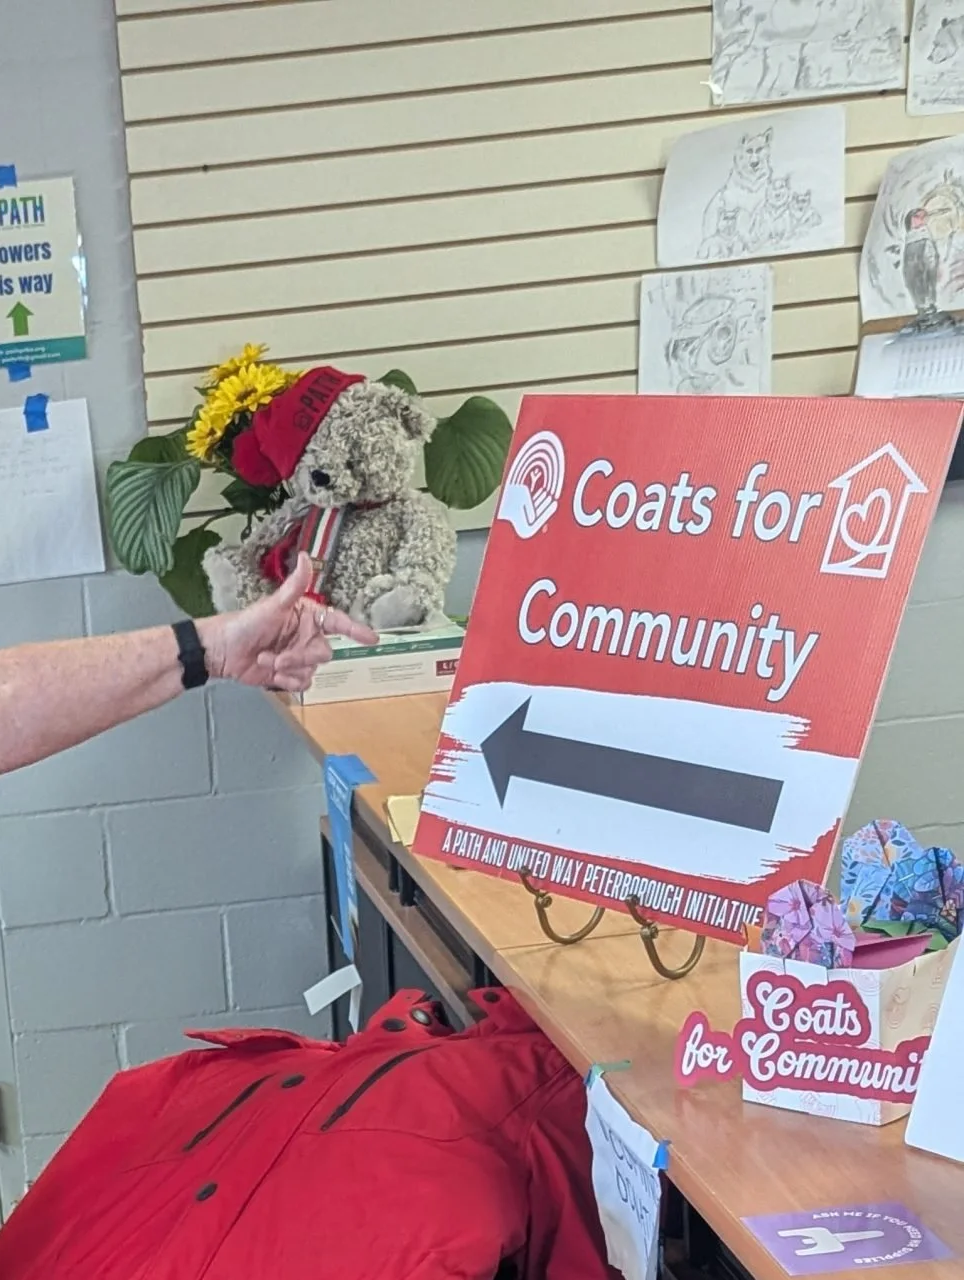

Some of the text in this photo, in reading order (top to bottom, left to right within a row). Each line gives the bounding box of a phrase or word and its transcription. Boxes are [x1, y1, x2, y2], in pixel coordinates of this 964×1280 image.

[18, 273, 53, 294] way
[572, 459, 823, 543] Coats for
[517, 578, 819, 702] Community
[442, 827, 763, 932] A PATH AND UNITED WAY PETERBOROUGH INITIATIVE
[755, 981, 862, 1036] Coats
[682, 1023, 926, 1093] for Communi
[813, 1211, 840, 1219] ASK
[883, 1215, 908, 1226] YOU
